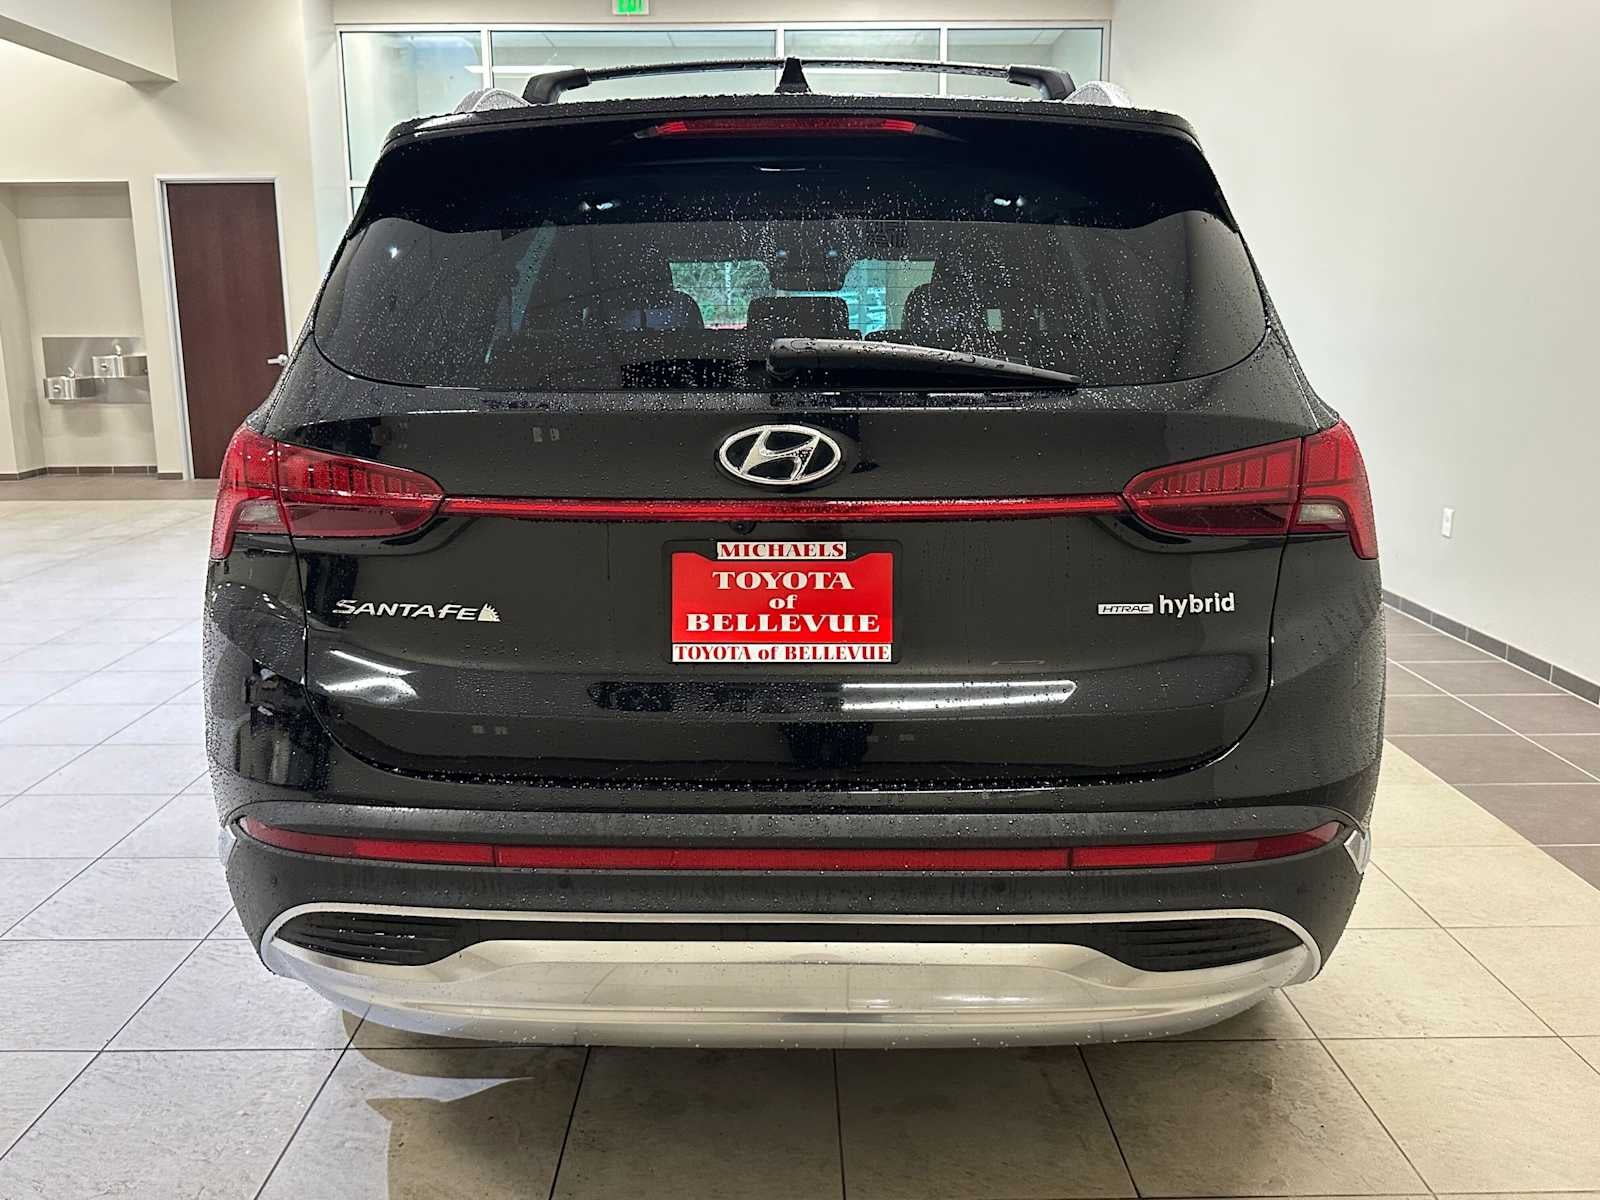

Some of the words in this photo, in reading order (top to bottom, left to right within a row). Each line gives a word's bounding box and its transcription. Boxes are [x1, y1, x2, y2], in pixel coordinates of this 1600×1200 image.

[720, 543, 845, 557] MICHAELS
[712, 571, 855, 590] TOYOTA
[768, 594, 798, 609] of
[1101, 605, 1151, 613] HTRAC
[1159, 592, 1236, 618] hybrid
[686, 613, 881, 632] BELLEVUE
[674, 646, 752, 660] TOYOTA
[758, 645, 779, 660] of
[785, 646, 890, 660] BELLEVUE
